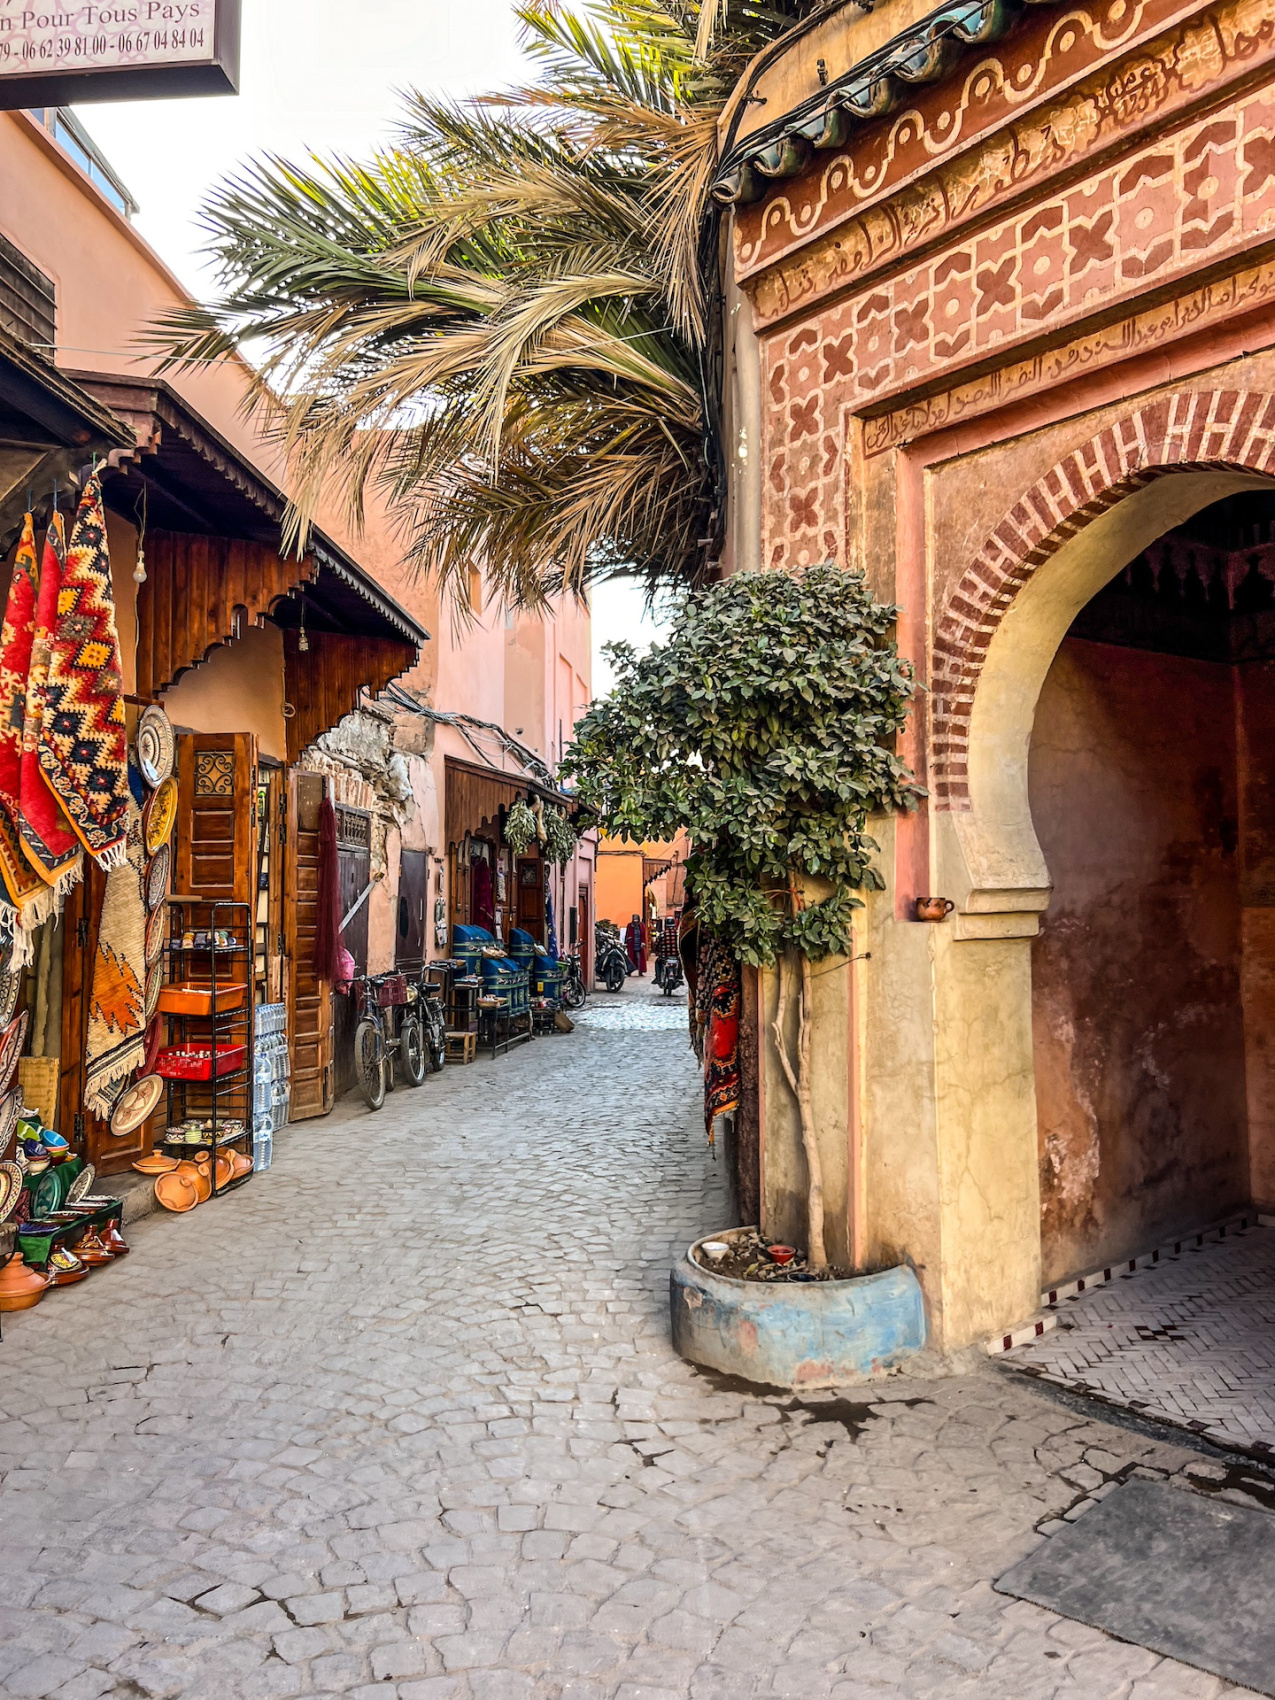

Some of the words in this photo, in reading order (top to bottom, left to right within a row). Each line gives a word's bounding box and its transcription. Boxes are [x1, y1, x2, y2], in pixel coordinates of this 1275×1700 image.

[21, 11, 75, 29] Pour
[81, 6, 138, 25] Tous
[145, 1, 200, 23] Pays
[22, 40, 36, 60] 06
[39, 39, 53, 59] 62
[56, 37, 71, 58] 39
[74, 36, 88, 56] 81
[92, 34, 107, 55] 00
[118, 32, 132, 53] 06
[136, 31, 150, 51] 67
[153, 30, 168, 50] 04
[171, 28, 186, 49] 84
[189, 27, 204, 48] 04
